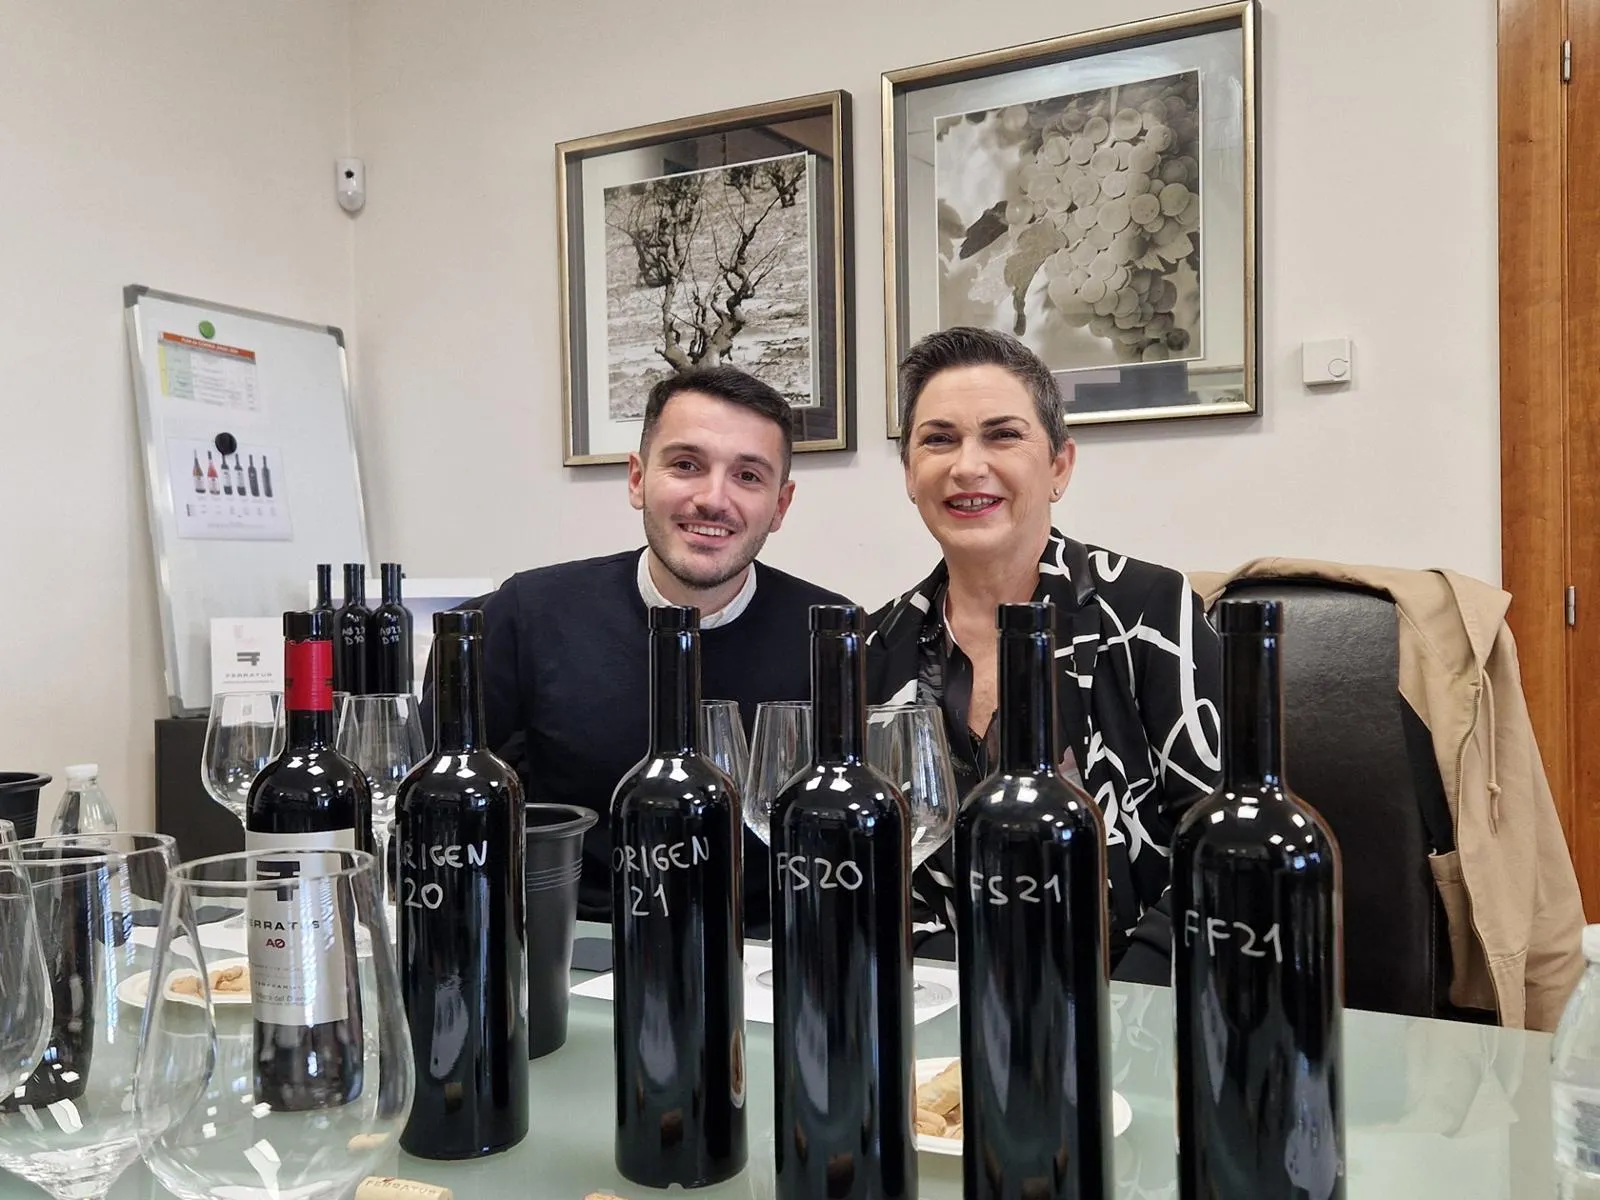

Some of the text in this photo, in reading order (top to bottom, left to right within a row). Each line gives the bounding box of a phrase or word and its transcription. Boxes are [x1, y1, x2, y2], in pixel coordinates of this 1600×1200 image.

[401, 840, 488, 870] RIGEN
[614, 836, 711, 878] ORIGEN
[776, 852, 864, 891] FS20
[404, 877, 443, 910] 20
[630, 885, 671, 919] 21
[969, 871, 1063, 905] FS21
[249, 919, 320, 930] ERRATS
[1183, 909, 1284, 964] FF21
